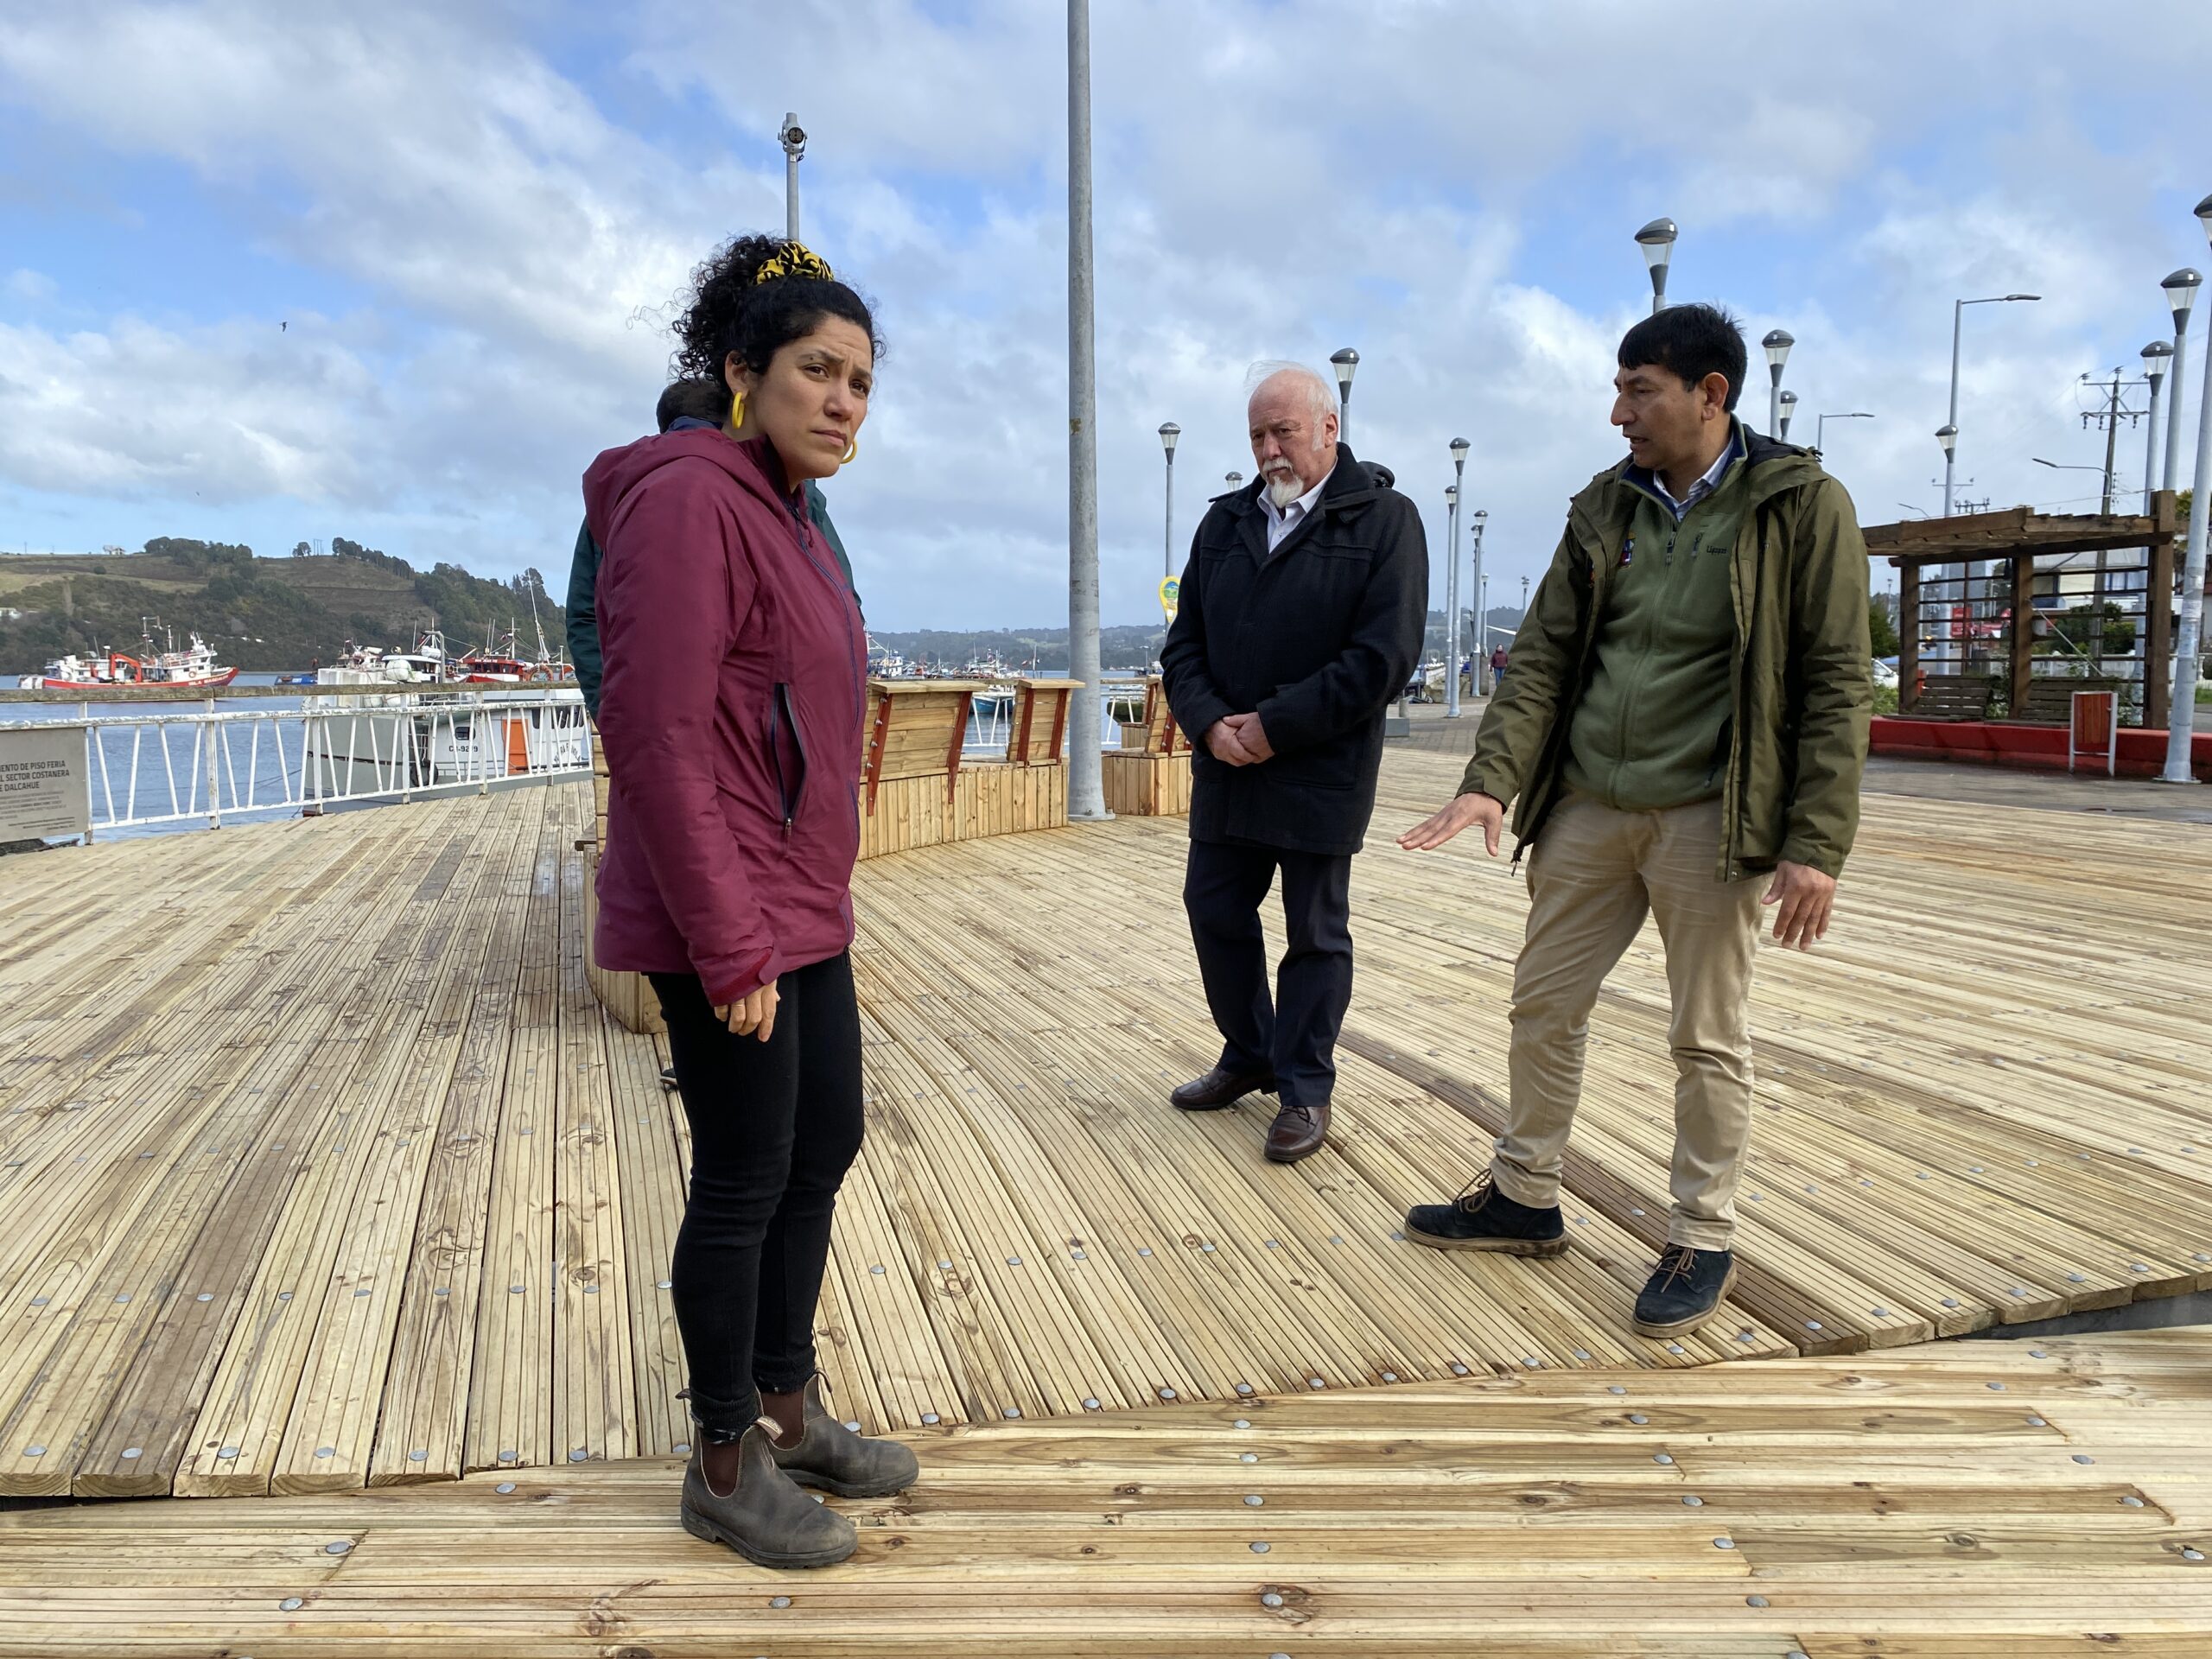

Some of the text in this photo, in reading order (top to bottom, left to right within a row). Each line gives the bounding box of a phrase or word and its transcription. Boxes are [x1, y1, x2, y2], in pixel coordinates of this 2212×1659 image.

[6, 773, 30, 781] SECTOR
[32, 769, 70, 779] COSTANERA
[4, 782, 40, 791] DALCAHUE
